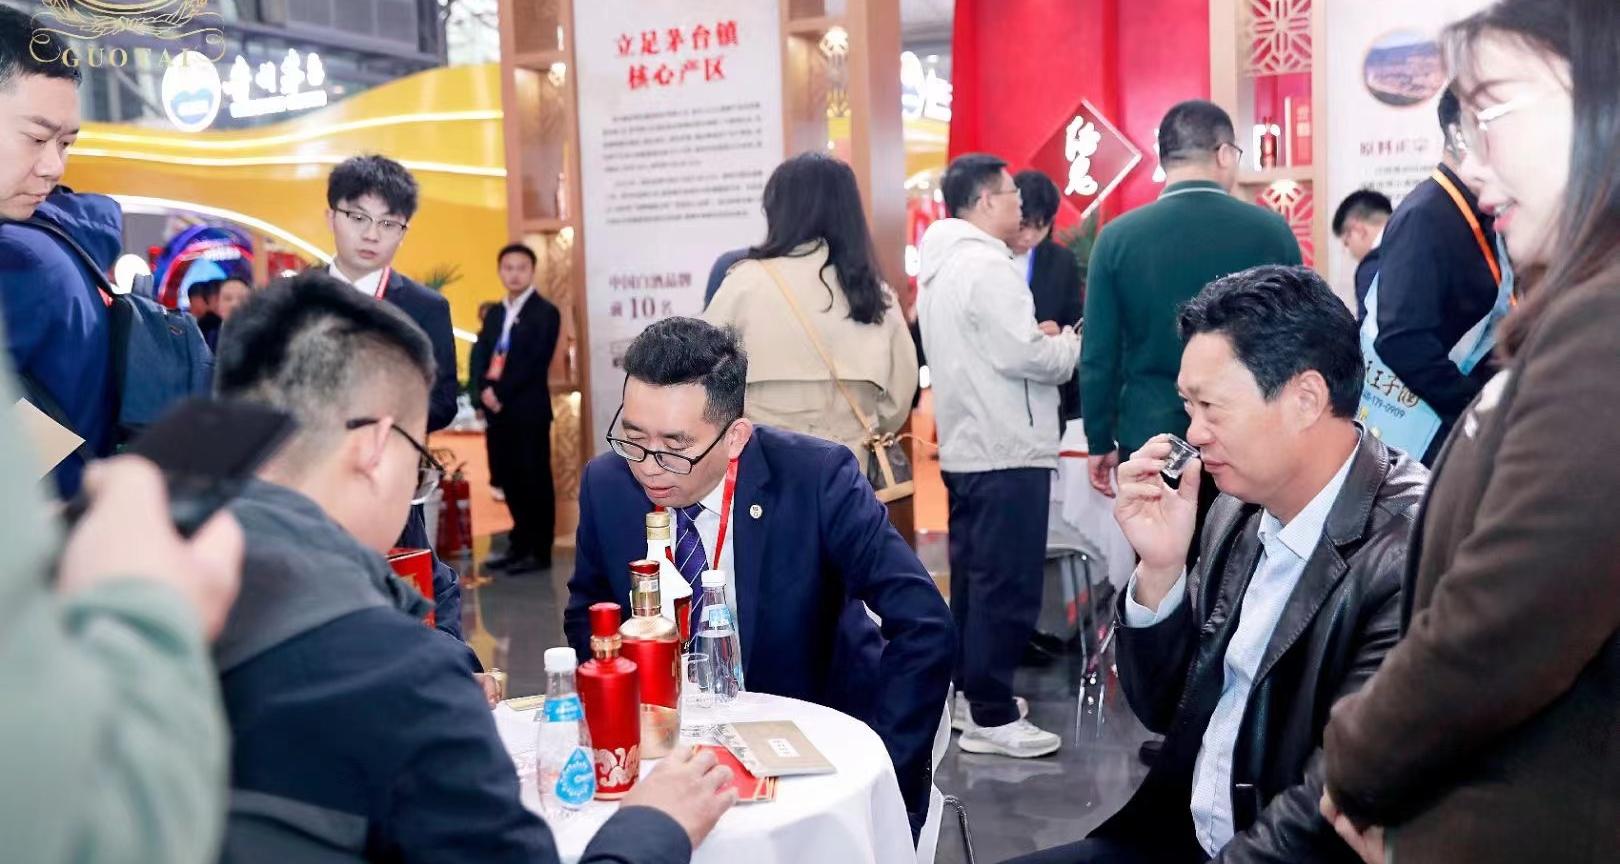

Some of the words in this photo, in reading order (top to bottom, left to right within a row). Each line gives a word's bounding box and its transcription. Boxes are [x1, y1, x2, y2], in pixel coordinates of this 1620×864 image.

[615, 20, 738, 59] 立足茅台镇
[629, 56, 726, 91] 核心产区
